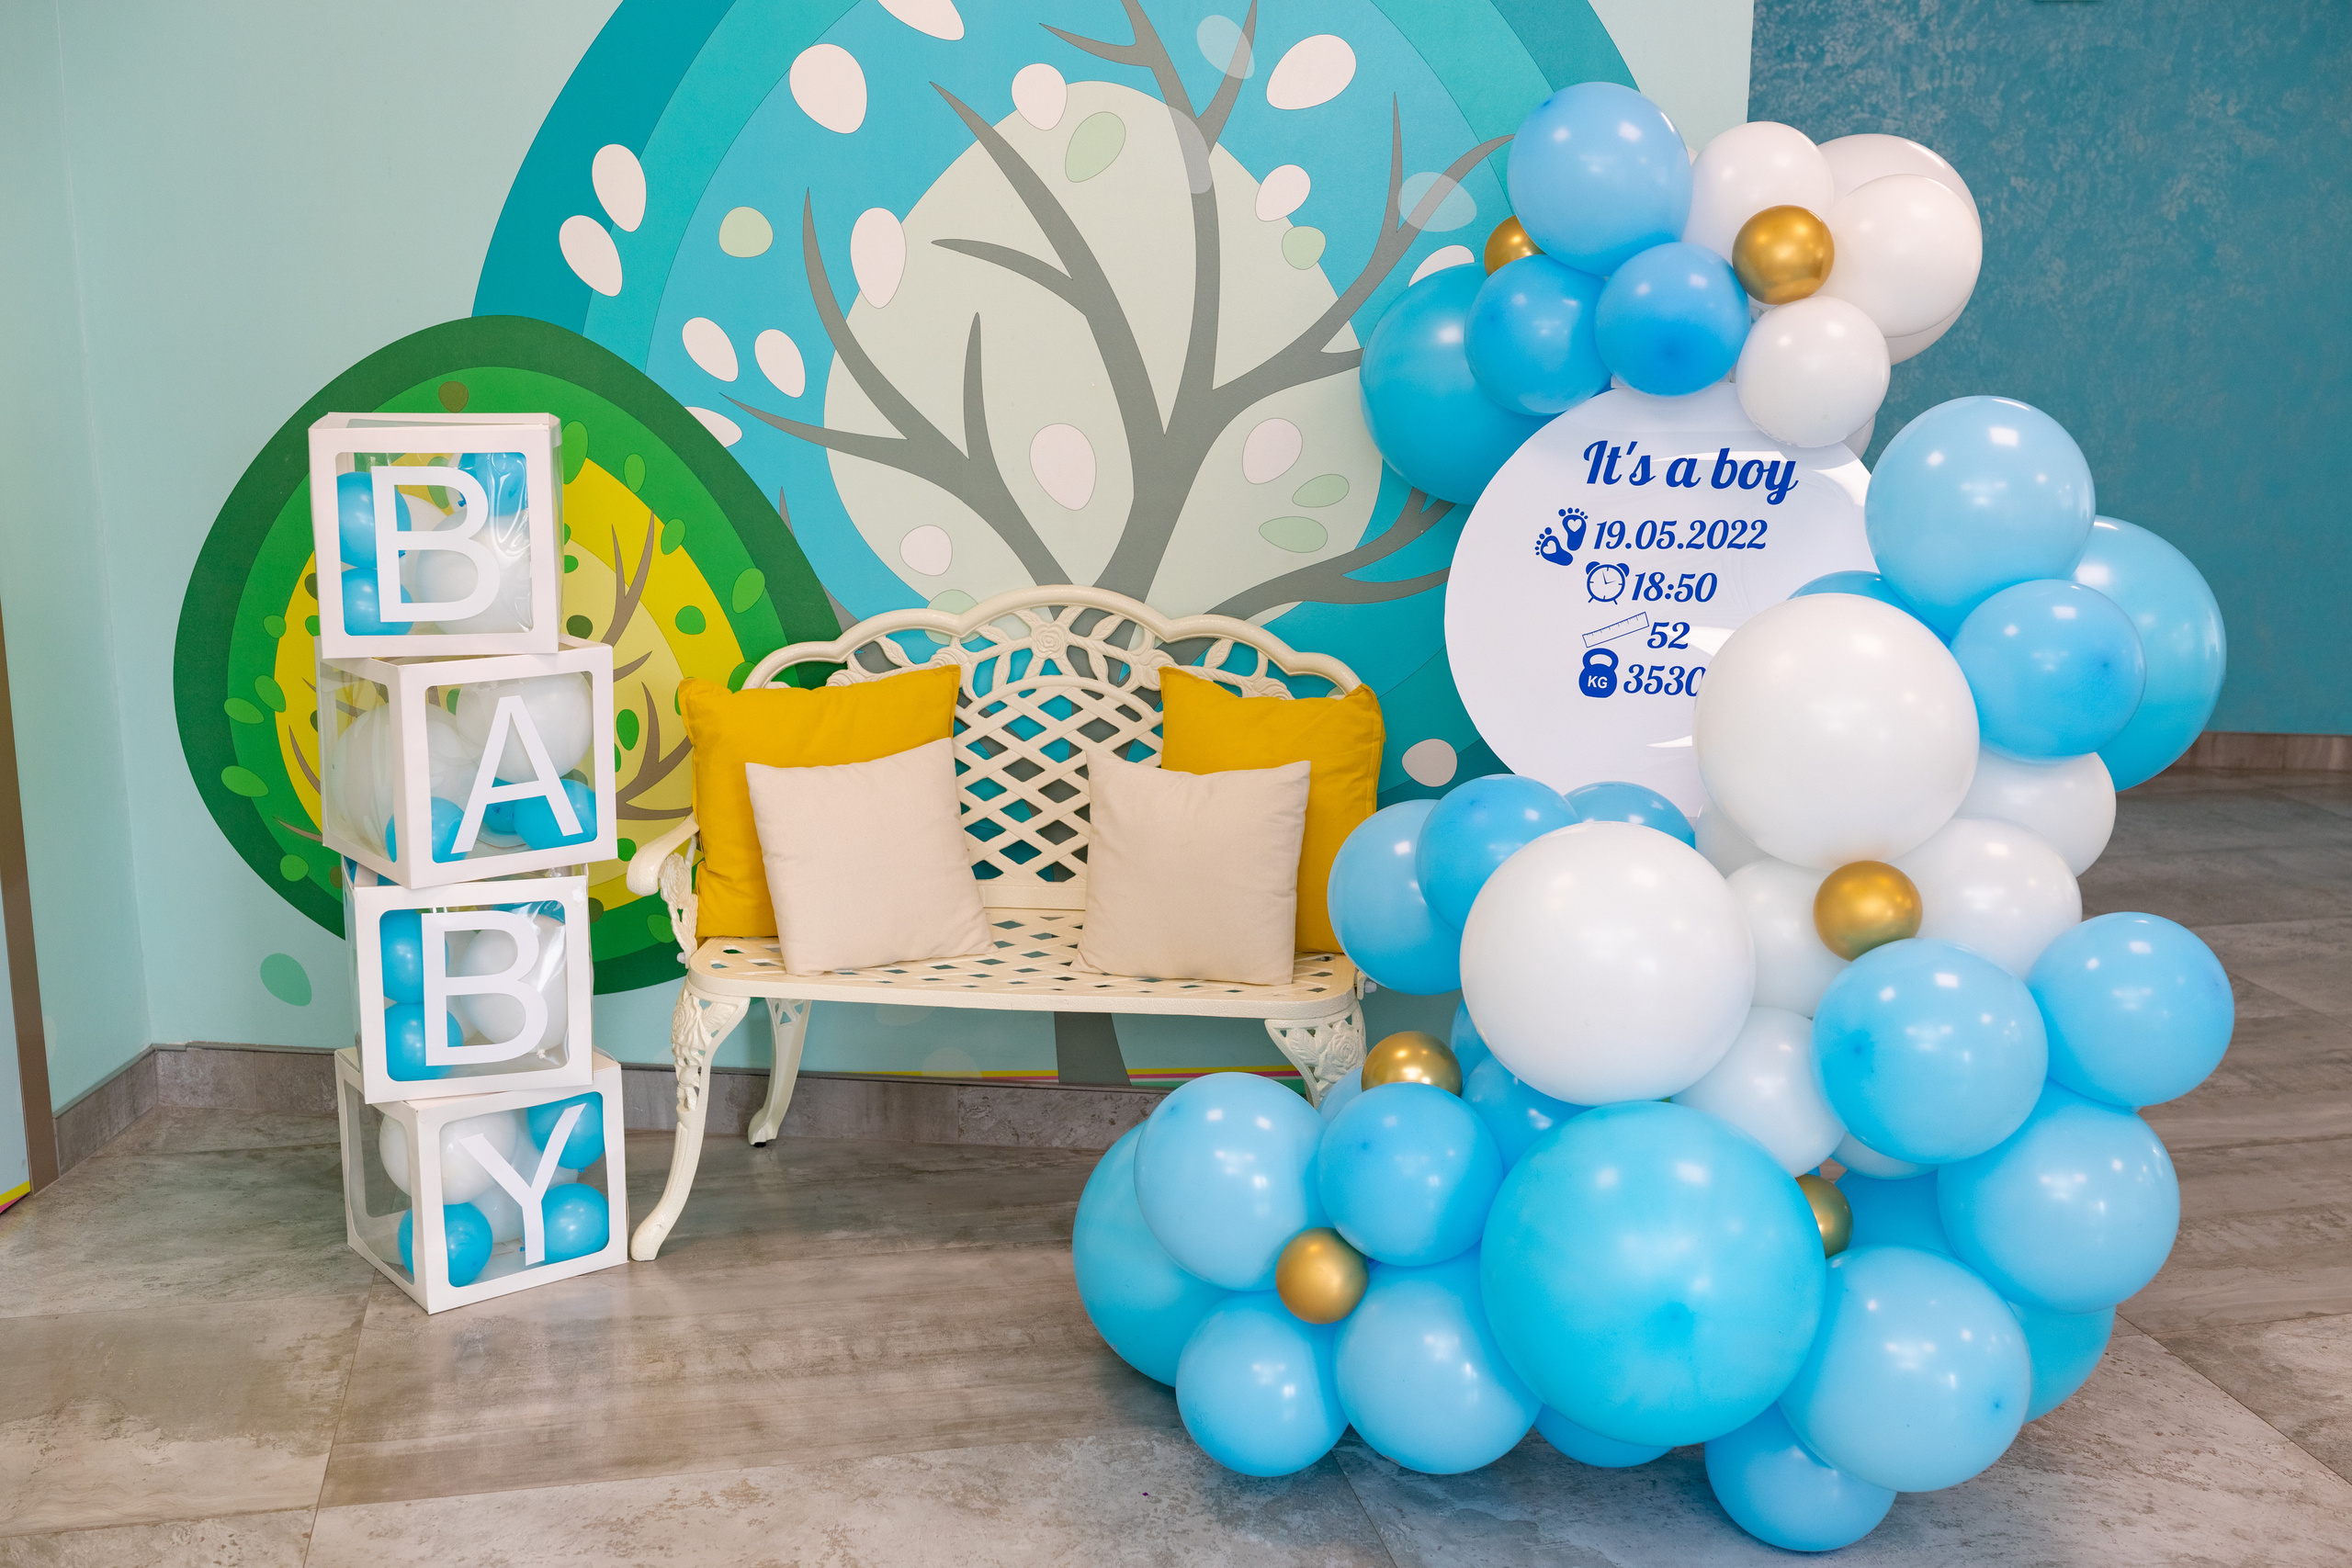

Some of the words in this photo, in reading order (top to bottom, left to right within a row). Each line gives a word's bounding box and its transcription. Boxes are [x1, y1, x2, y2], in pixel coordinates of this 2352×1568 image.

[1583, 440, 1656, 487] It's
[1666, 457, 1702, 489] a
[1710, 447, 1799, 505] boy
[1593, 519, 1768, 550] 19.05.2022
[1631, 571, 1718, 603] 18:50
[1646, 621, 1690, 650] 52
[1587, 675, 1609, 689] KG
